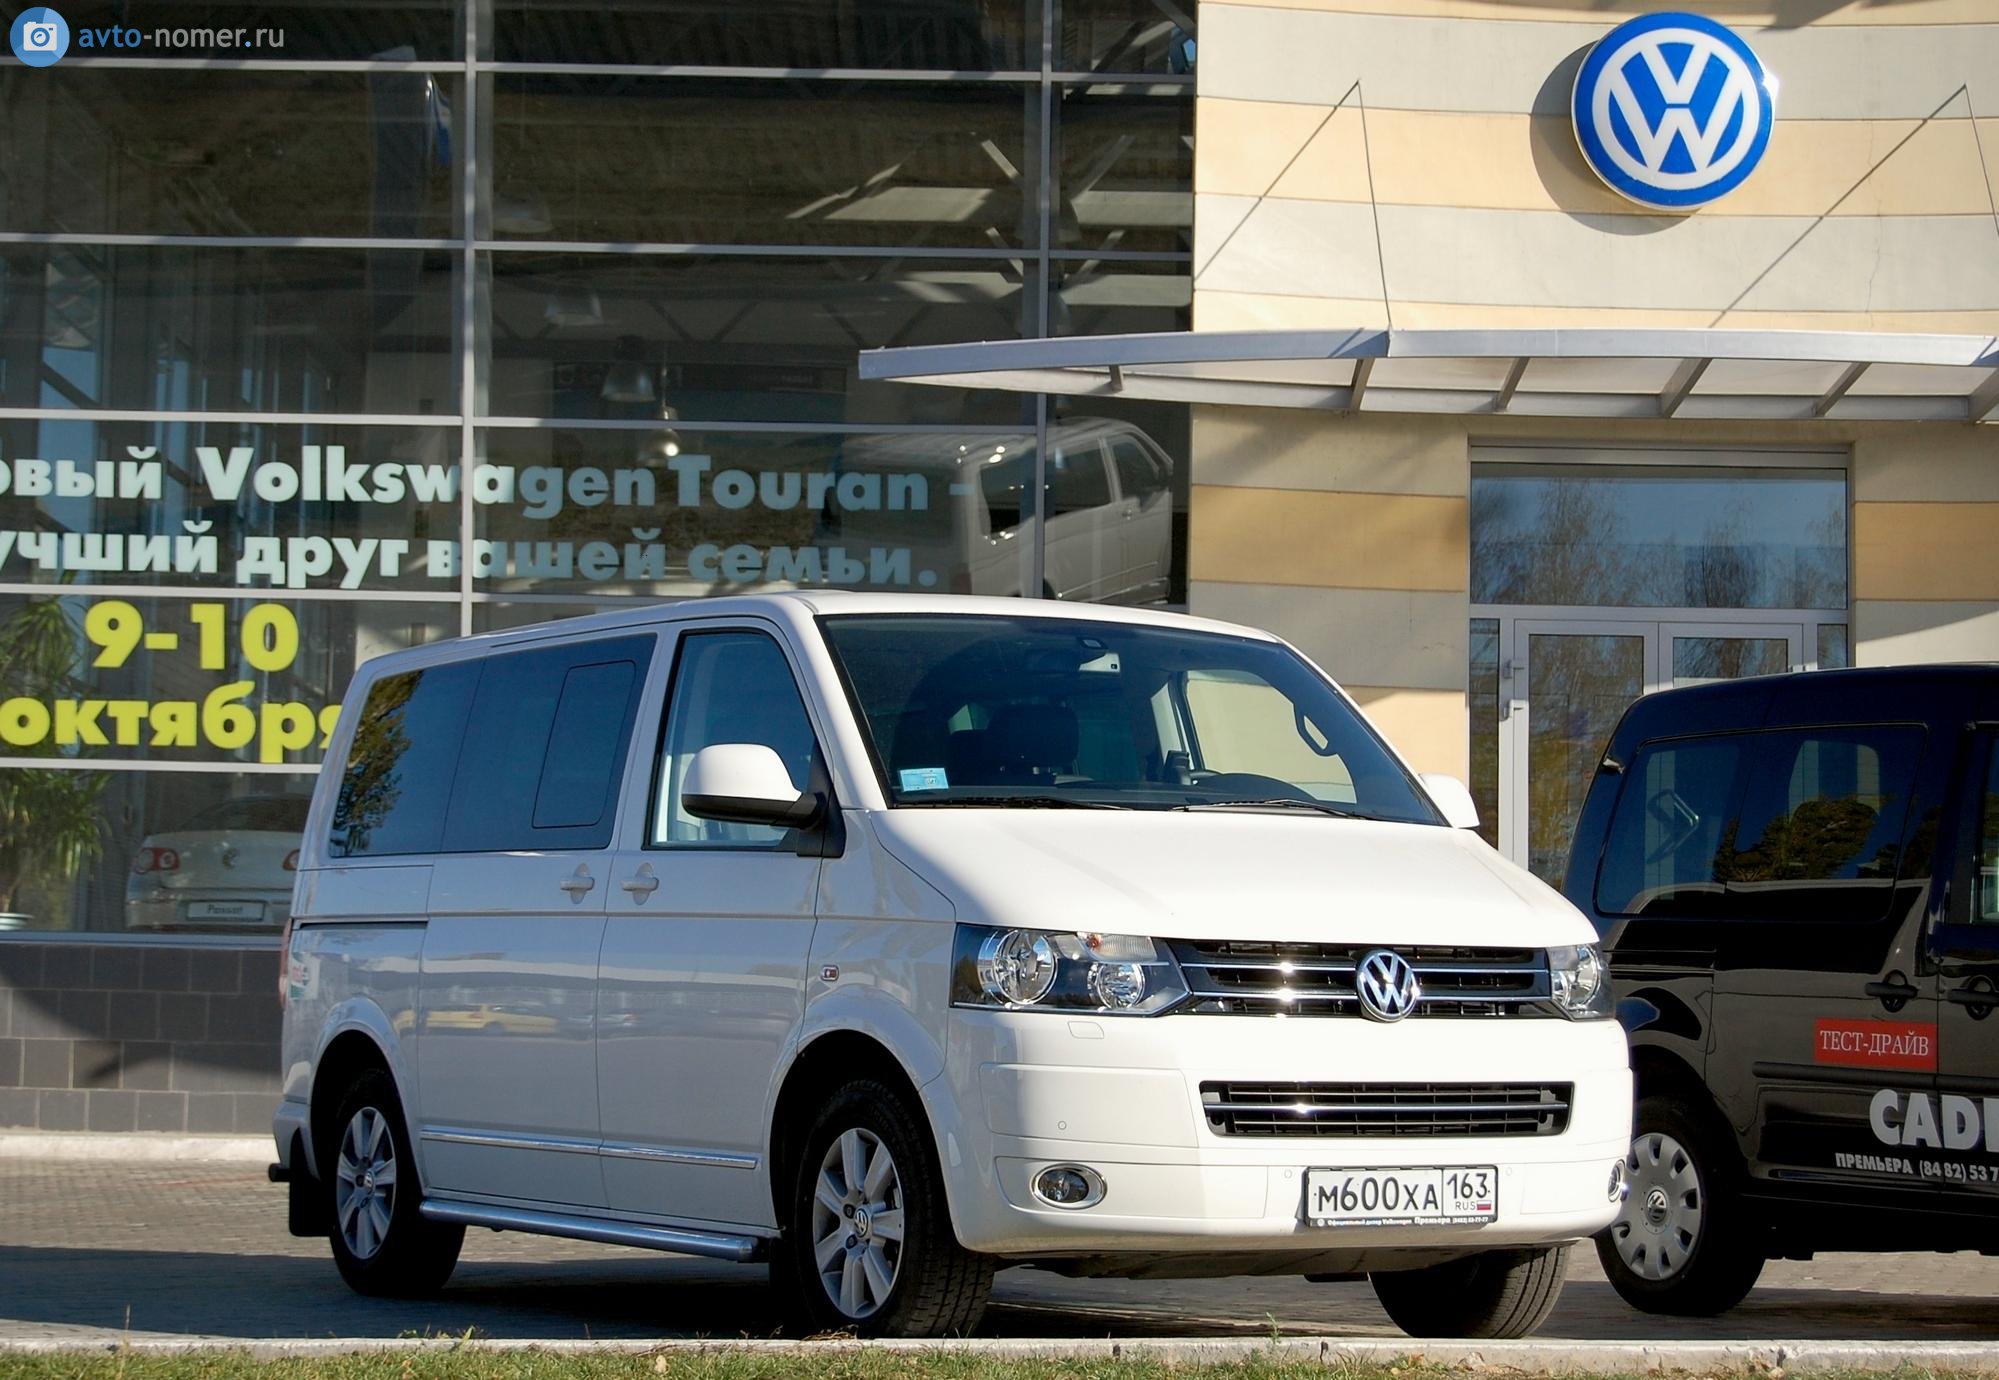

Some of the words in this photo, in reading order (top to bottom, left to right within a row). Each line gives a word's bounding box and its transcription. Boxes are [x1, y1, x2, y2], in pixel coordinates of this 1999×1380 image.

[0, 446, 162, 499] вый
[196, 446, 656, 519] Volkswagen
[669, 455, 928, 512] Touran
[236, 535, 409, 589] друг
[427, 528, 666, 582] вашей
[687, 540, 937, 587] семьи.
[84, 600, 300, 671] 9-10
[1820, 1029, 1929, 1056] ТЕСТ-ДРАЙВ
[1835, 1152, 1914, 1175] ПРЕМЬЕРА
[1446, 1173, 1488, 1199] 163
[1455, 1202, 1475, 1211] RUS
